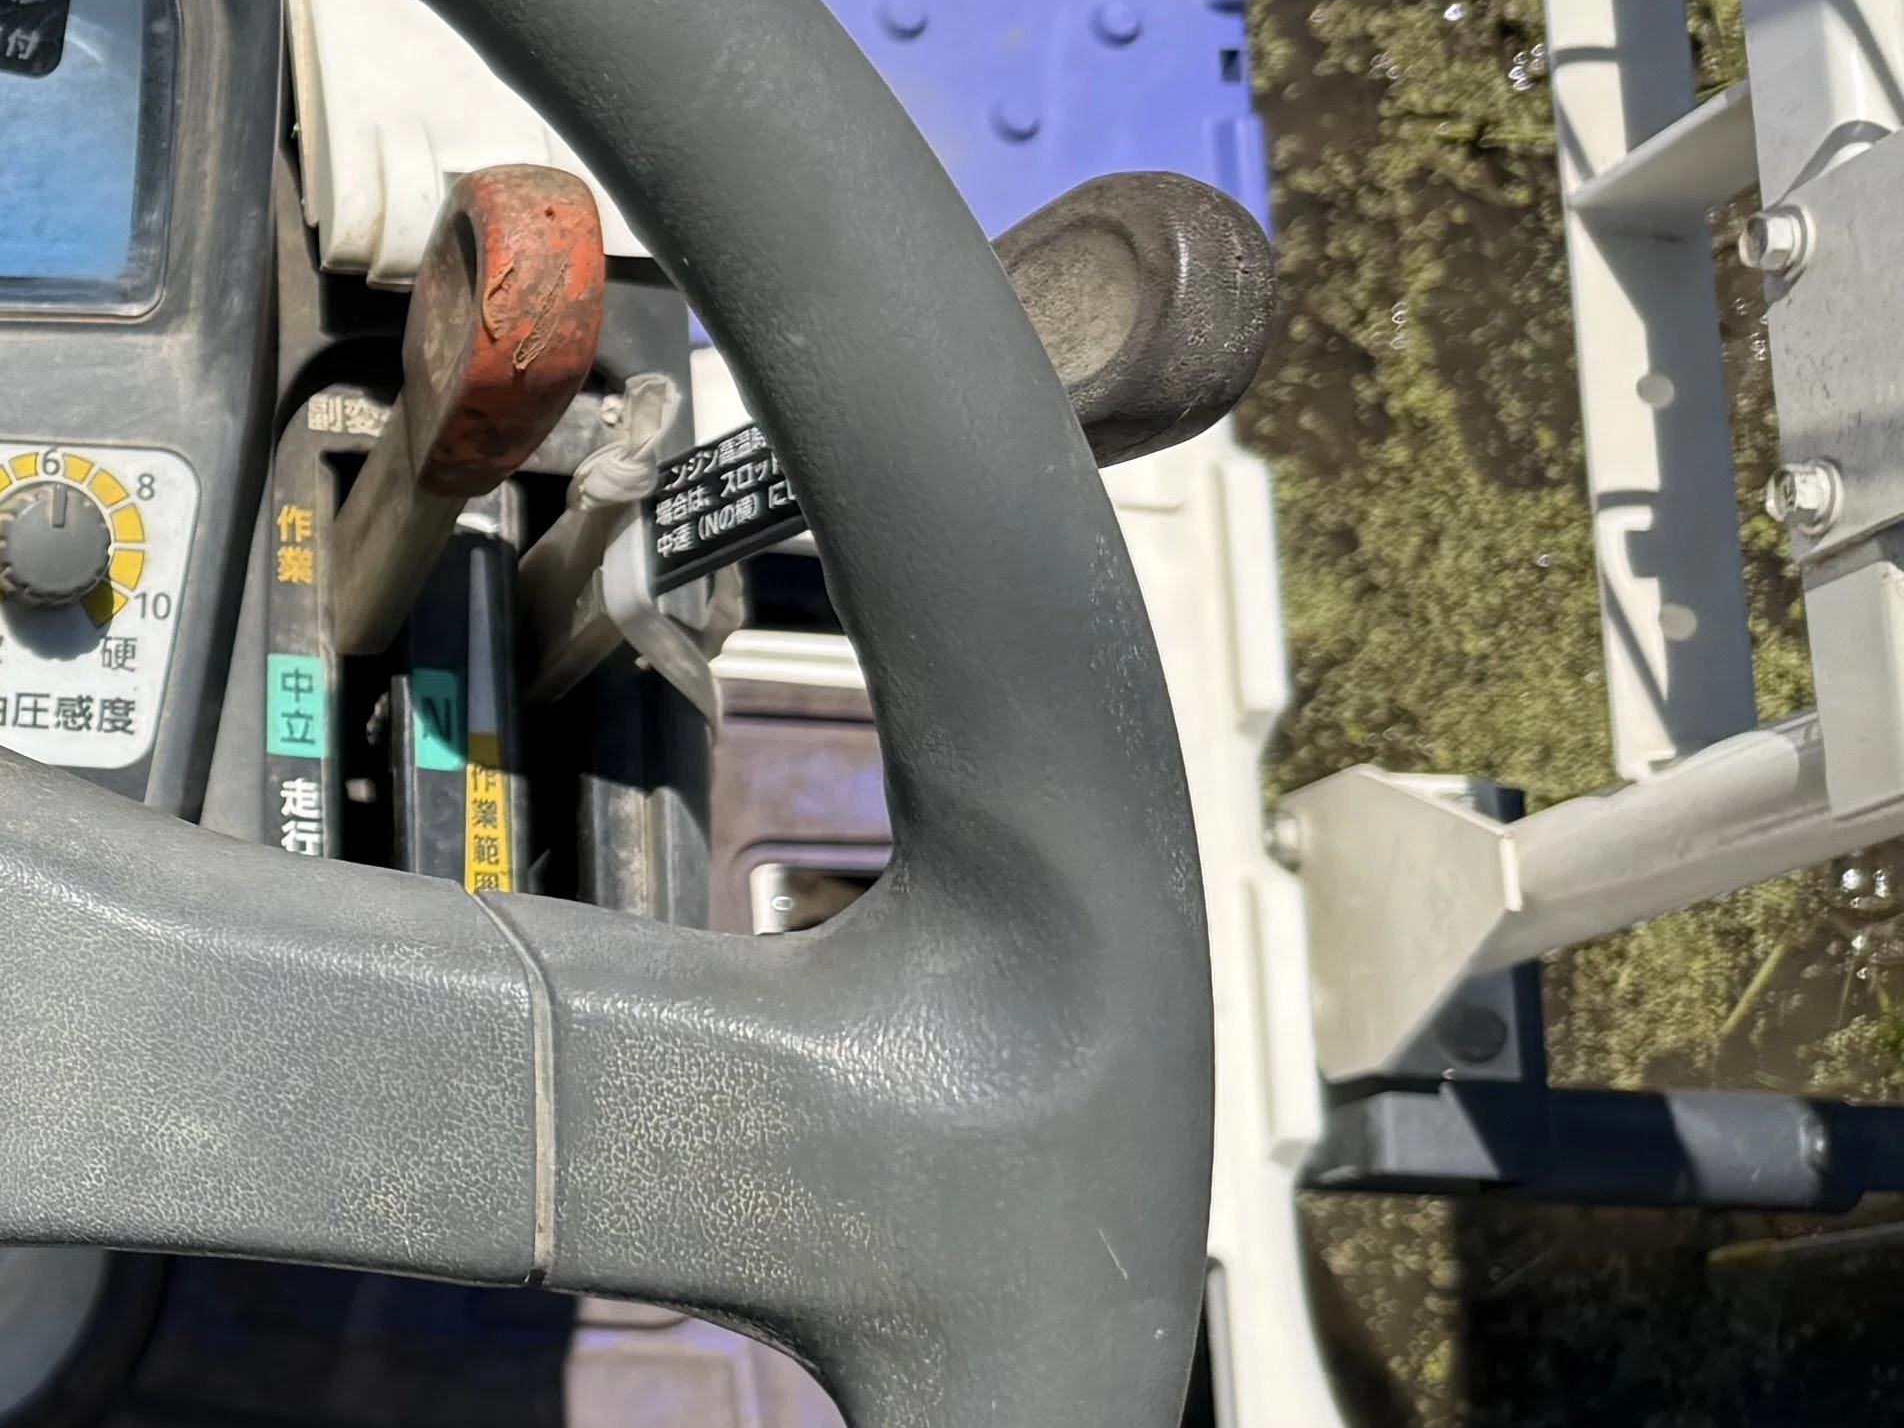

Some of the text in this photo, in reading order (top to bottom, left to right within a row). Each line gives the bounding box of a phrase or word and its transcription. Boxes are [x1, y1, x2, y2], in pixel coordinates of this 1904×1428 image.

[41, 447, 60, 476] 6
[135, 473, 156, 501] 8
[277, 504, 314, 584] 作業
[133, 591, 172, 621] 10
[99, 635, 138, 672] 硬
[280, 666, 317, 746] 中立
[280, 776, 323, 857] 走行
